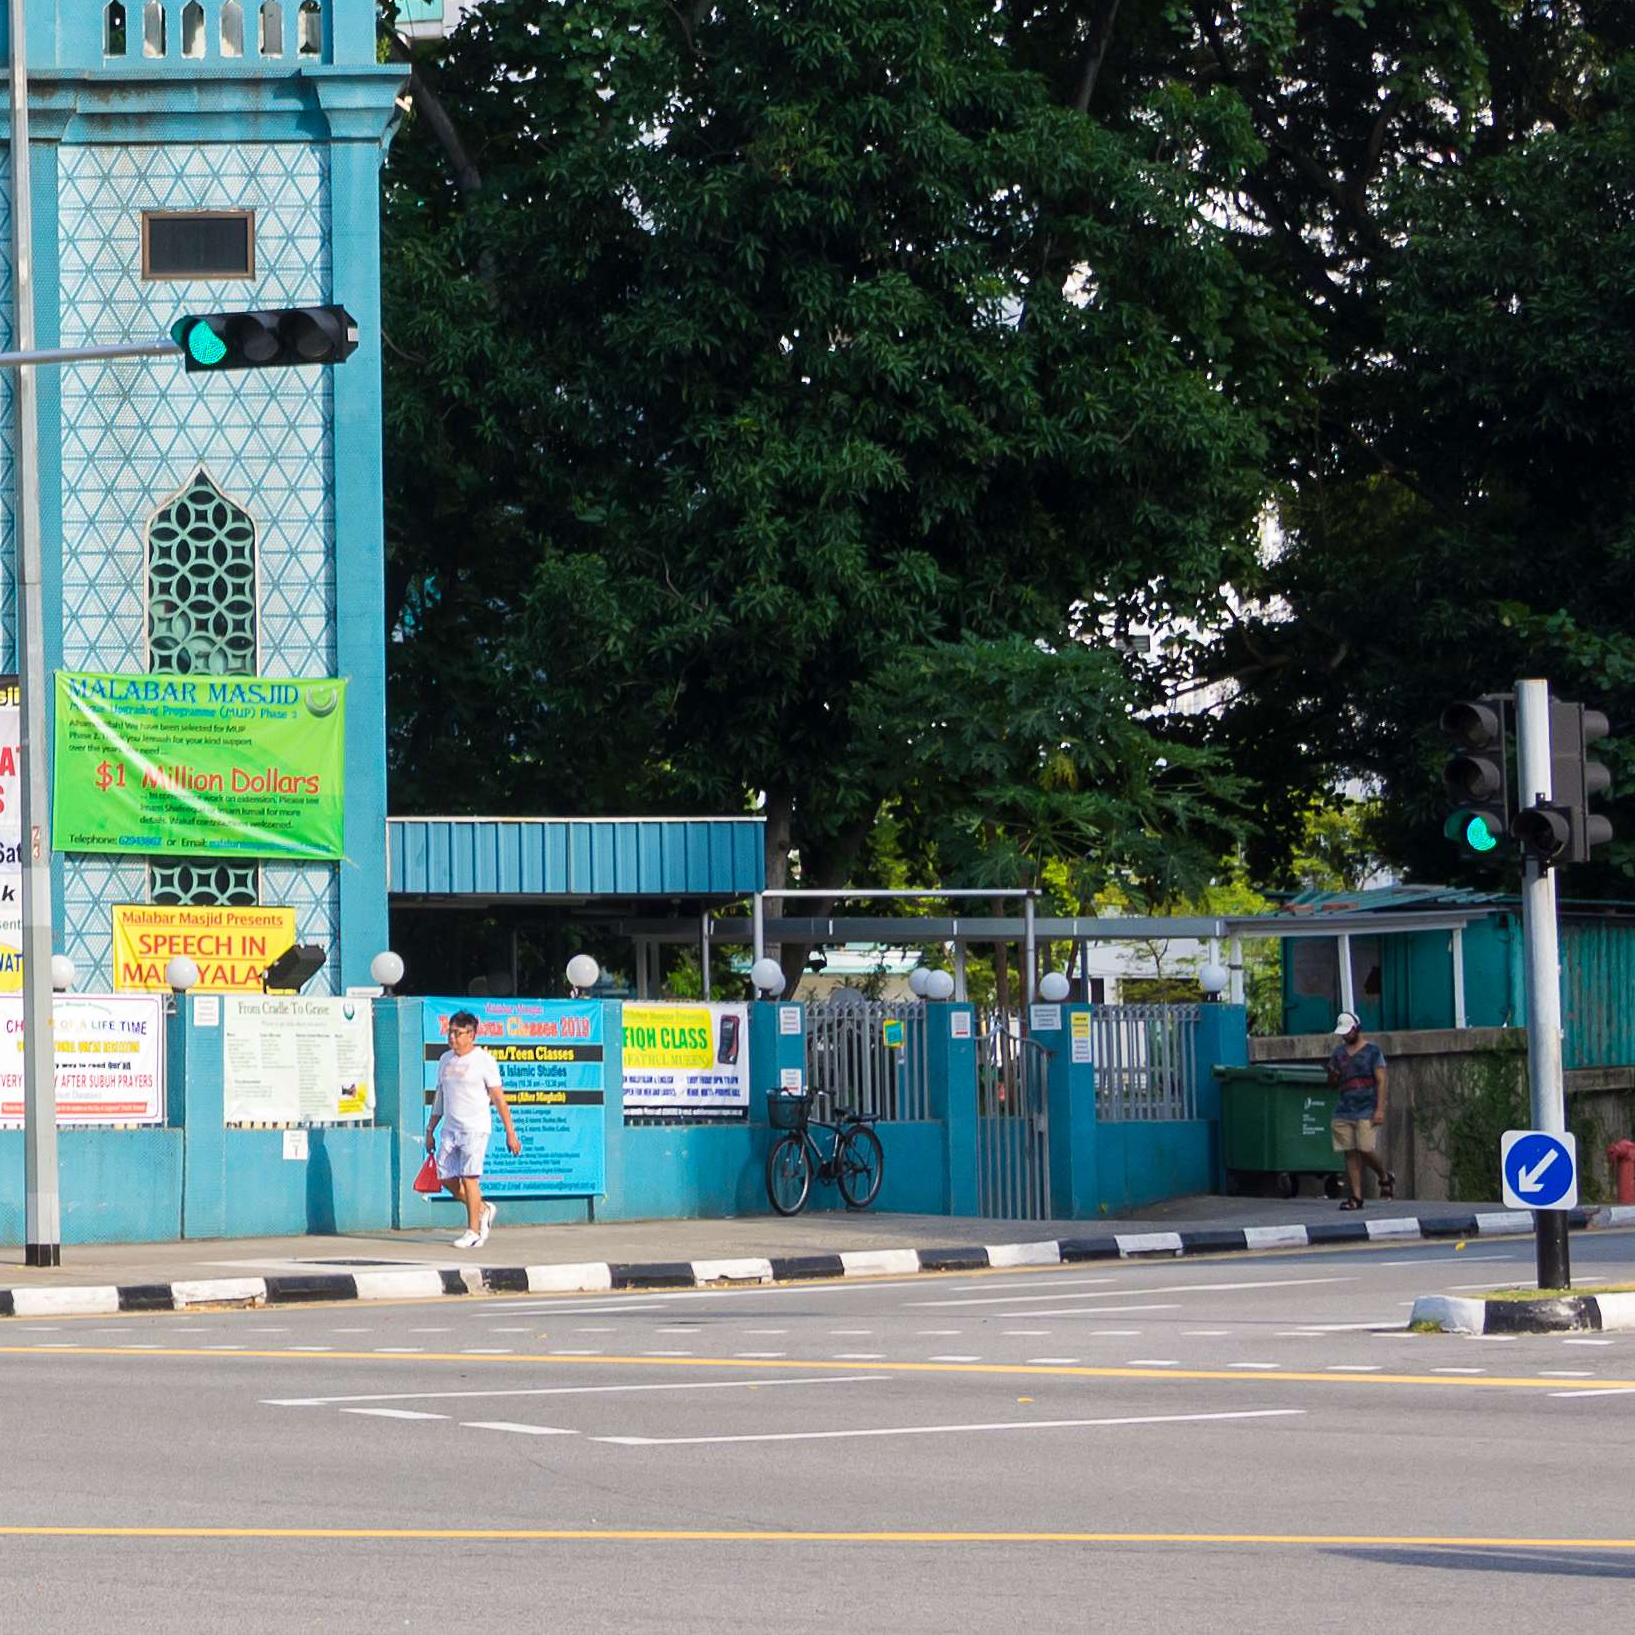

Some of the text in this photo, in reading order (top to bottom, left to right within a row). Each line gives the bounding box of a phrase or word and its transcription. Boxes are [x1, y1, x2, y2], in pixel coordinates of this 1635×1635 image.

[69, 679, 299, 706] MALABAR MASJID
[95, 761, 319, 793] $1 Million Dollars
[122, 912, 283, 927] Malabar Masjid Presents
[138, 934, 266, 956] SPEECH IN
[238, 1001, 330, 1014] From Cradle To Grave
[91, 1021, 115, 1031] LIFE
[120, 1021, 147, 1035] TIME
[507, 1017, 557, 1037] Classes
[622, 1027, 708, 1051] FIQH CLASS
[536, 1046, 574, 1060] Classes
[507, 1065, 535, 1076] Islamic
[537, 1065, 567, 1076] Studies
[61, 1075, 86, 1087] AFTER
[90, 1075, 115, 1087] SUBUH
[118, 1075, 152, 1087] PRAYERS
